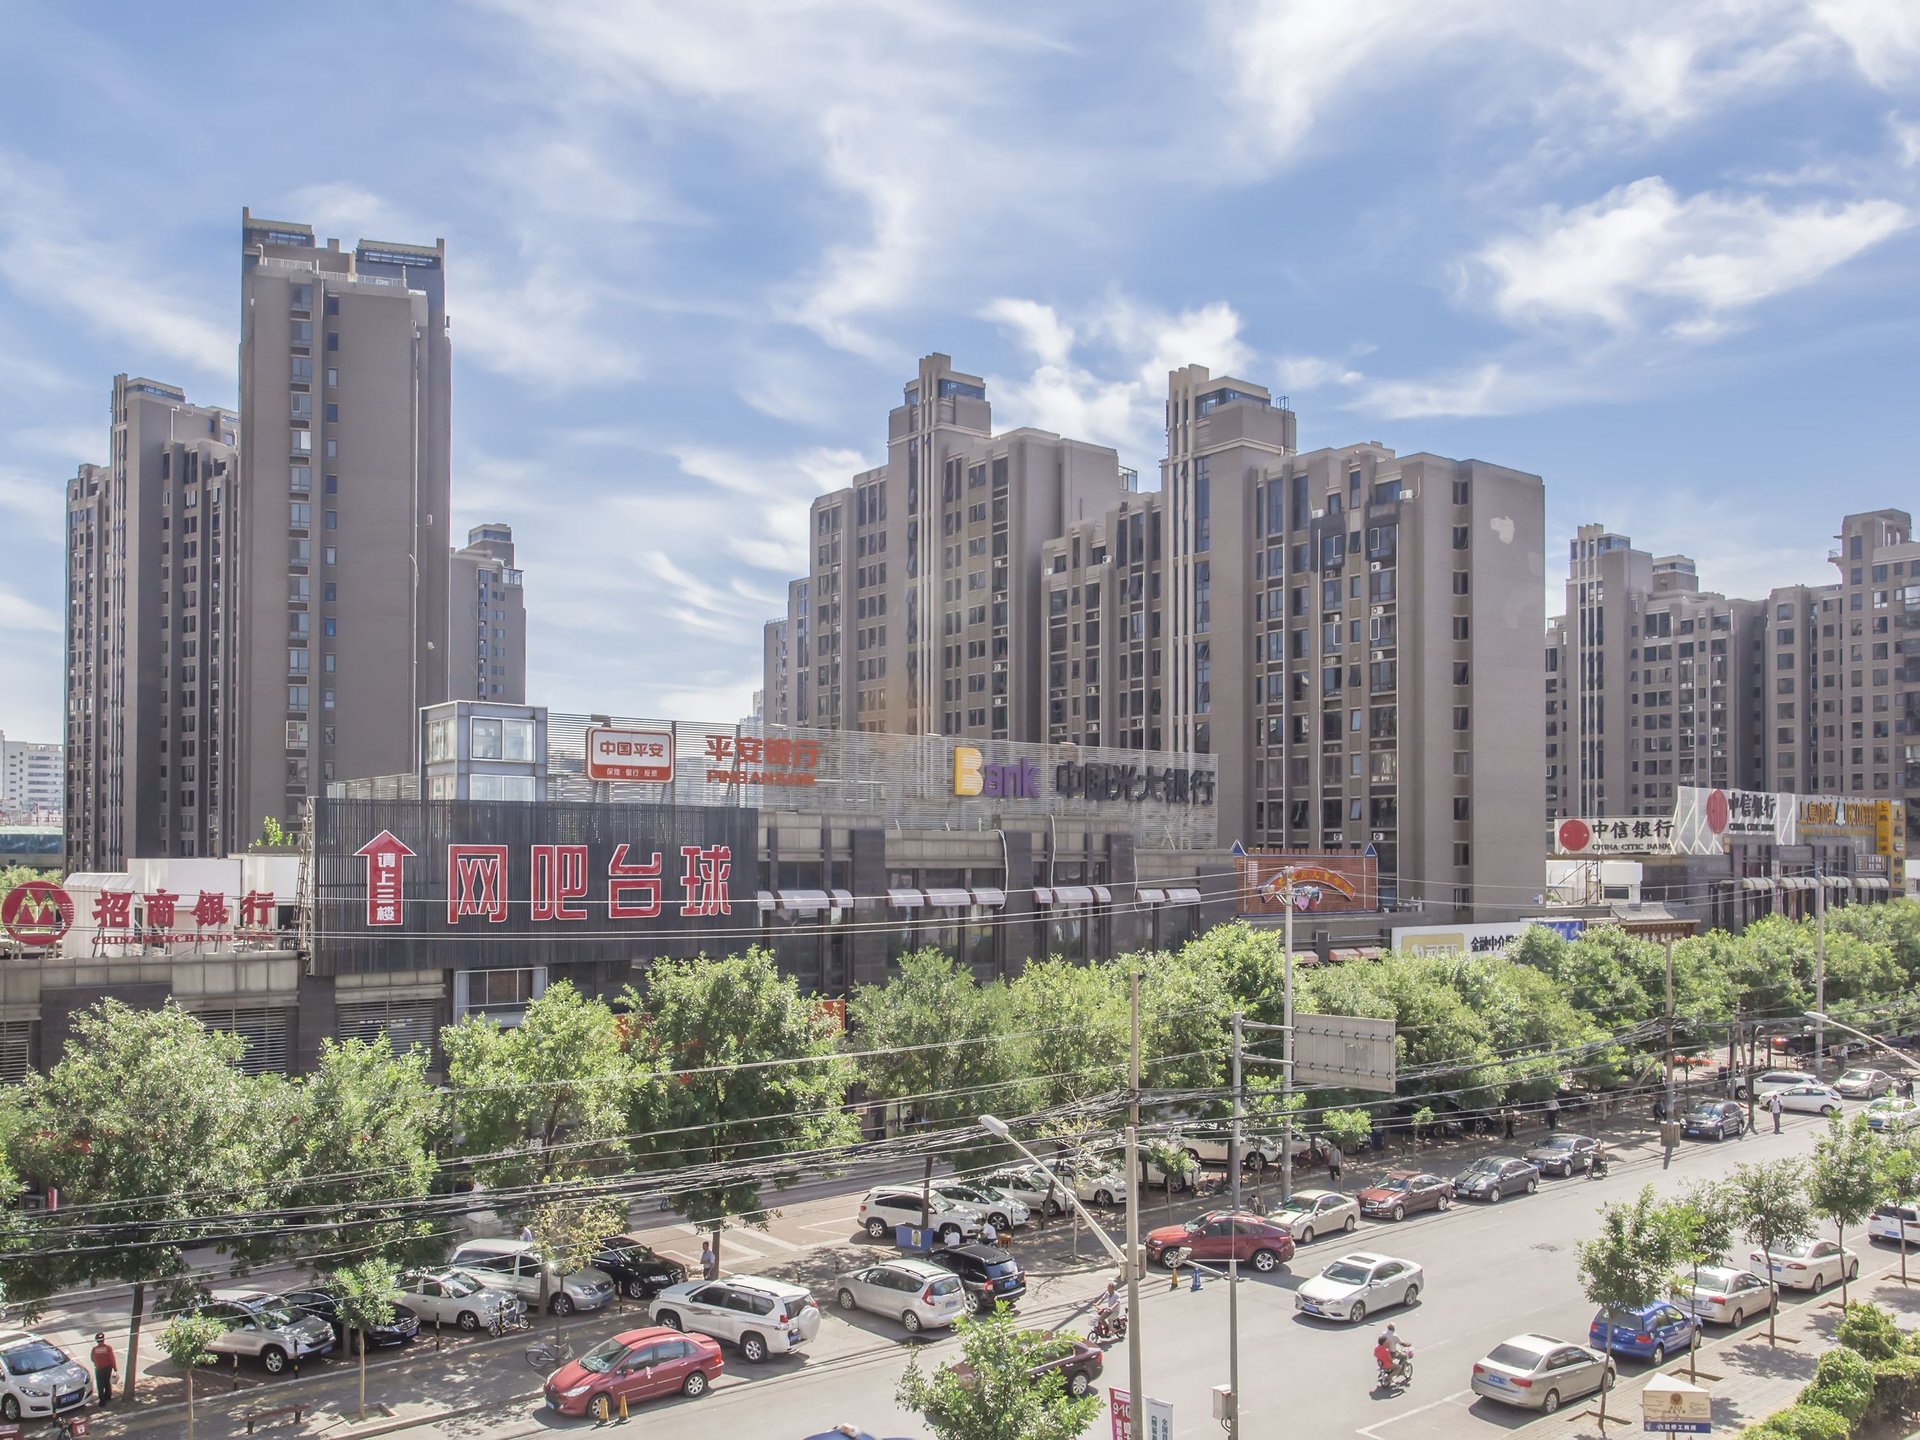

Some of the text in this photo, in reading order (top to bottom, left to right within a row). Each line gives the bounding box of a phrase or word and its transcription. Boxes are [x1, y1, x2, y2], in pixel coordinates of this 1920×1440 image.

[599, 740, 664, 757] 中国平安
[704, 734, 820, 768] 平安银行
[953, 745, 1040, 798] Bank
[1056, 760, 1216, 806] 中国光大银行
[1728, 792, 1776, 820] 中信银行
[1592, 819, 1674, 839] 中信银行
[1592, 843, 1672, 852] CHINA CITIC BANK
[376, 852, 396, 922] 请上三楼
[447, 843, 732, 924] 网吧台球
[91, 935, 138, 945] CHINA
[142, 934, 233, 944] MERCHANTS
